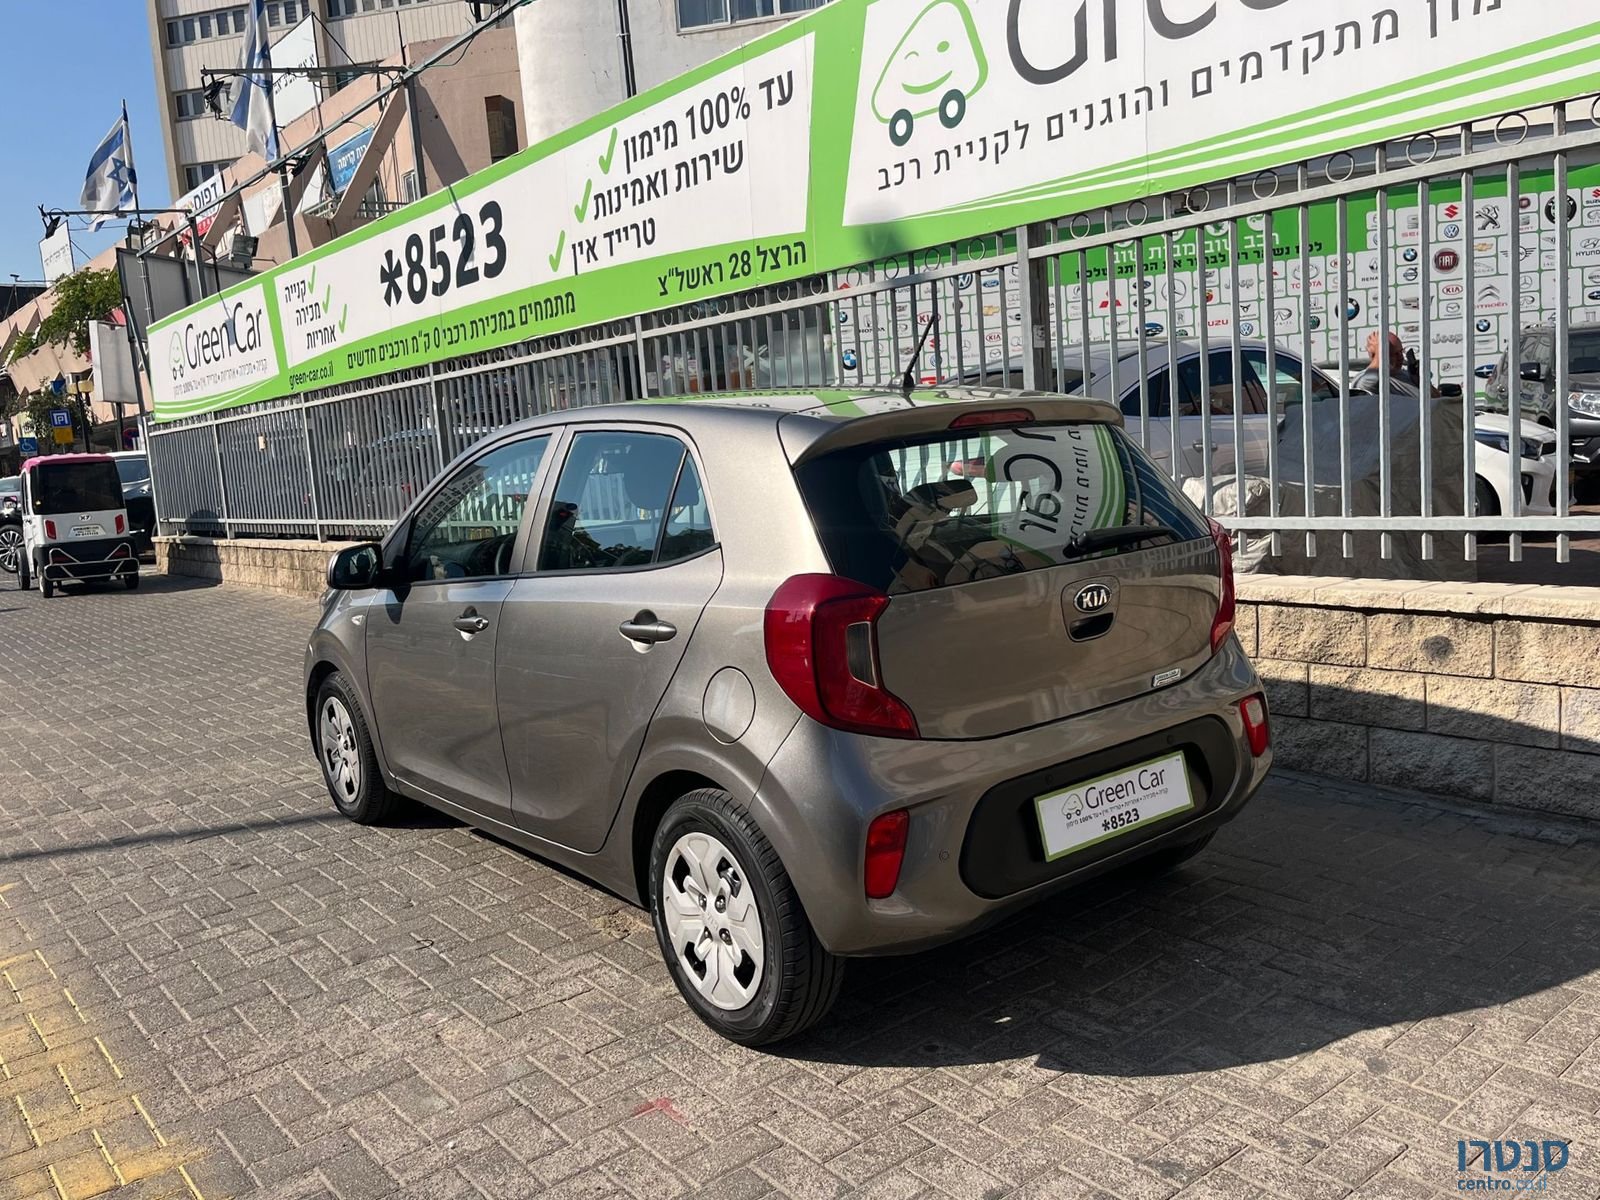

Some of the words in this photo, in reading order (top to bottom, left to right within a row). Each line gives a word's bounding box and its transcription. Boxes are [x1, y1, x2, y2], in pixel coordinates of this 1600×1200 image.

[1191, 8, 1399, 98] מתקדמים
[758, 70, 794, 110] עד
[685, 86, 751, 140] 100%
[1046, 79, 1169, 141] והוגנים
[623, 119, 678, 174] מימון
[933, 119, 1030, 174] לקניית
[675, 140, 744, 193] שירות
[877, 158, 921, 191] רכב
[193, 182, 218, 211] דפוס
[593, 168, 668, 220] ואמינות
[603, 217, 656, 257] טרייד
[1253, 246, 1290, 259] נשר
[571, 235, 599, 276] אין
[728, 249, 751, 280] 28
[756, 240, 806, 273] הרצל
[1438, 256, 1454, 267] FIAT
[284, 280, 307, 303] קנייה
[295, 302, 322, 327] מכירה
[470, 308, 516, 340] במכירת
[519, 291, 576, 326] מתמחים
[185, 321, 231, 370] Green
[233, 302, 262, 353] Car
[306, 324, 337, 350] אחריות
[379, 339, 409, 362] ורכבים
[433, 326, 441, 349] 0
[443, 323, 467, 346] רכבי
[347, 344, 377, 370] חדשים
[289, 361, 334, 390] green-car.co.il
[1081, 590, 1108, 609] KIA
[1085, 779, 1135, 809] Green
[1138, 769, 1165, 790] Car
[1080, 814, 1093, 823] 100%
